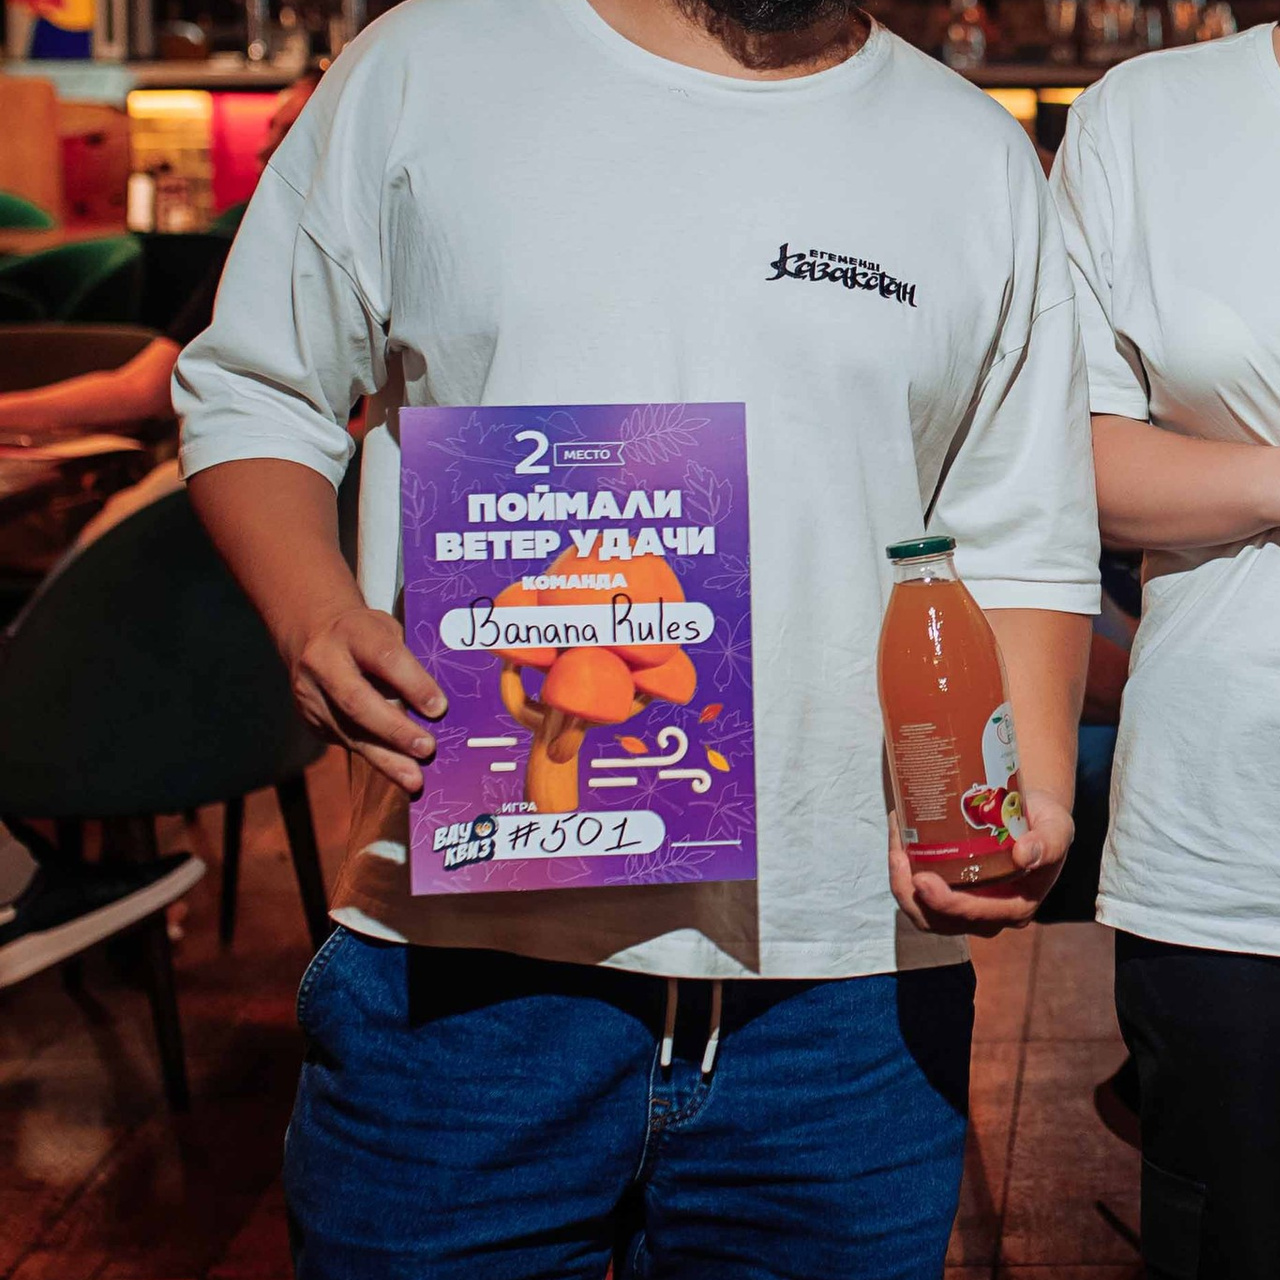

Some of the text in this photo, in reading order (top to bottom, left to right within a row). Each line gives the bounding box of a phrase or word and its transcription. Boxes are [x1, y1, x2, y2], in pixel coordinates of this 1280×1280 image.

[809, 248, 880, 272] ЕГЕМЕНДІ
[514, 430, 611, 475] 2 МЕСТО
[467, 484, 683, 523] ПОЙМАЛИ
[435, 526, 717, 562] ВЕТЕР УДАЧИ
[522, 573, 628, 591] КОМАНДА
[461, 592, 701, 647] Banana Rules
[501, 801, 538, 813] ИГРА
[433, 821, 473, 851] ВАУ
[508, 813, 643, 853] #501
[443, 838, 493, 868] КВИЗ
